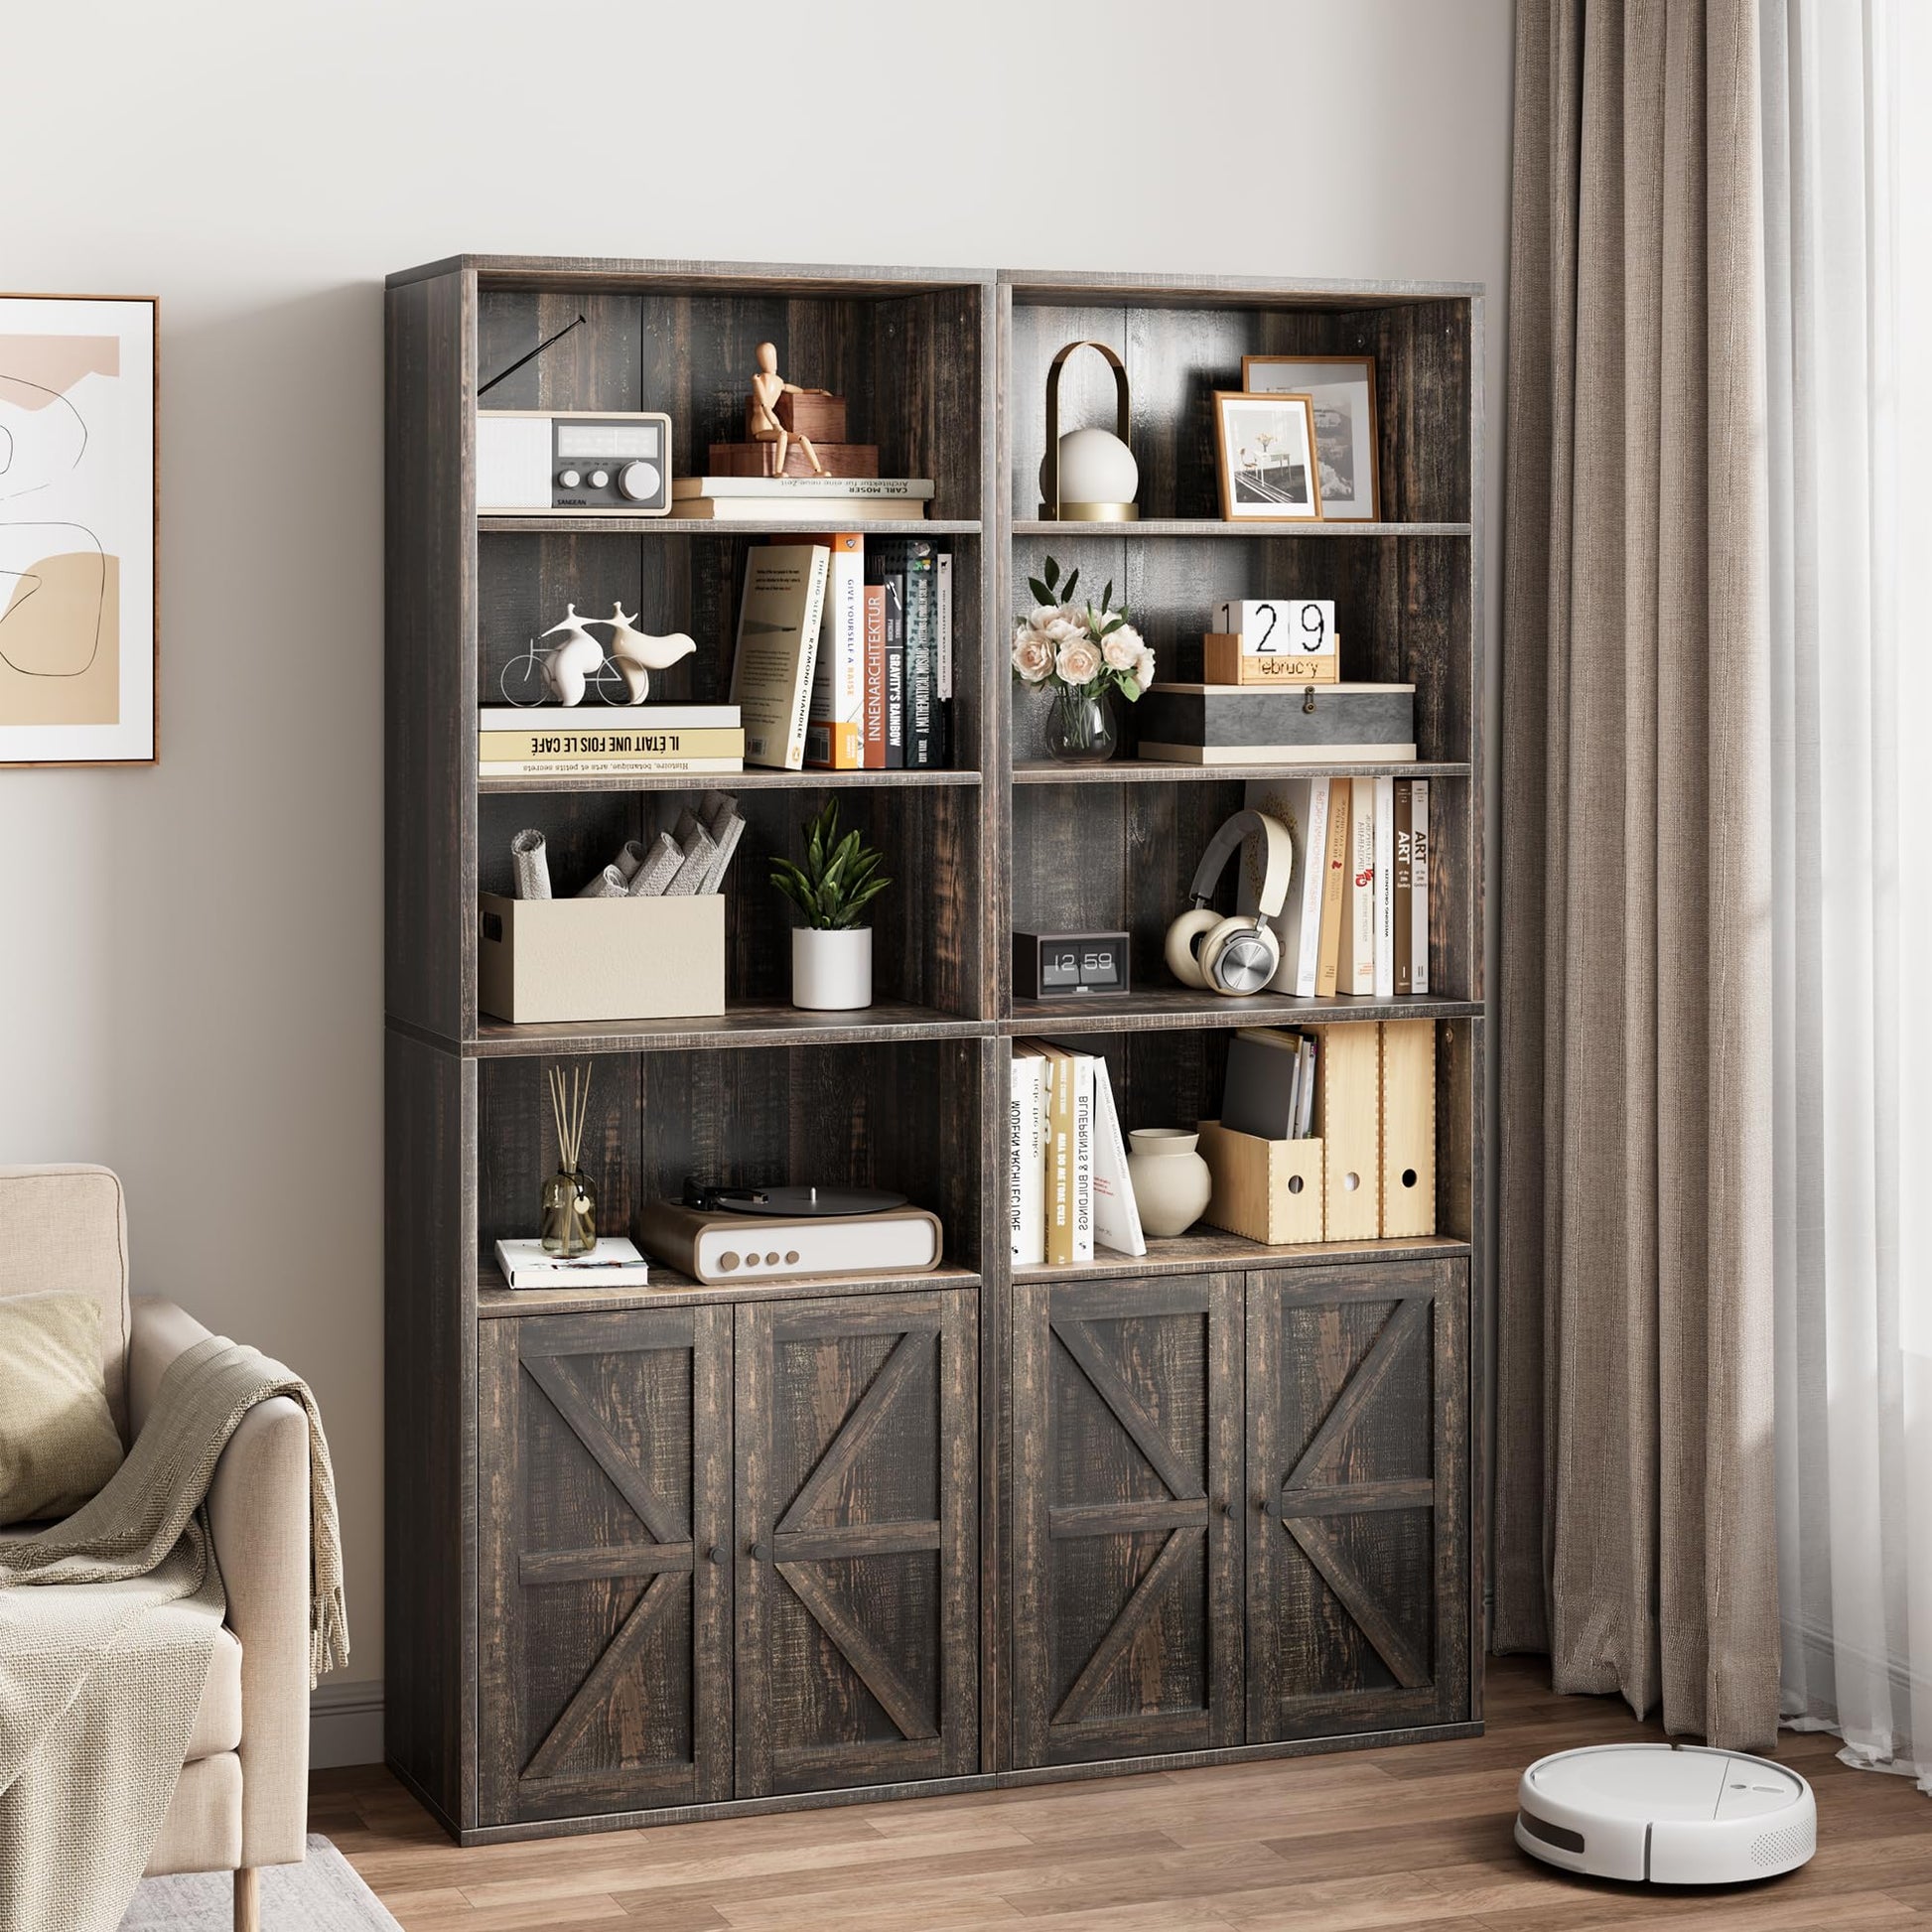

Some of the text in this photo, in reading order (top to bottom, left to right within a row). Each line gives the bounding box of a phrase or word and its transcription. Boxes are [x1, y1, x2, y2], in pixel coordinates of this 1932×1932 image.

[816, 559, 825, 578] THE
[811, 600, 820, 625] SLEEP
[1221, 604, 1230, 633] 1
[803, 636, 814, 687] RAYMOND
[868, 596, 882, 742] INNENARCHITEKTUR
[914, 647, 930, 674] MOSAIC
[889, 653, 901, 747] GRAVITY'S RAINBOW
[914, 675, 930, 727] MATHEMATICAL
[796, 689, 808, 740] CHANDLER
[531, 736, 679, 757] IL ÉTAIT UNE FOIS LE CAFÉ
[554, 763, 579, 772] petits
[611, 761, 652, 771] botanique,
[653, 761, 689, 770] Histoire,
[1397, 830, 1411, 866] ART
[1414, 830, 1428, 865] ART
[1055, 953, 1112, 971] 12 59
